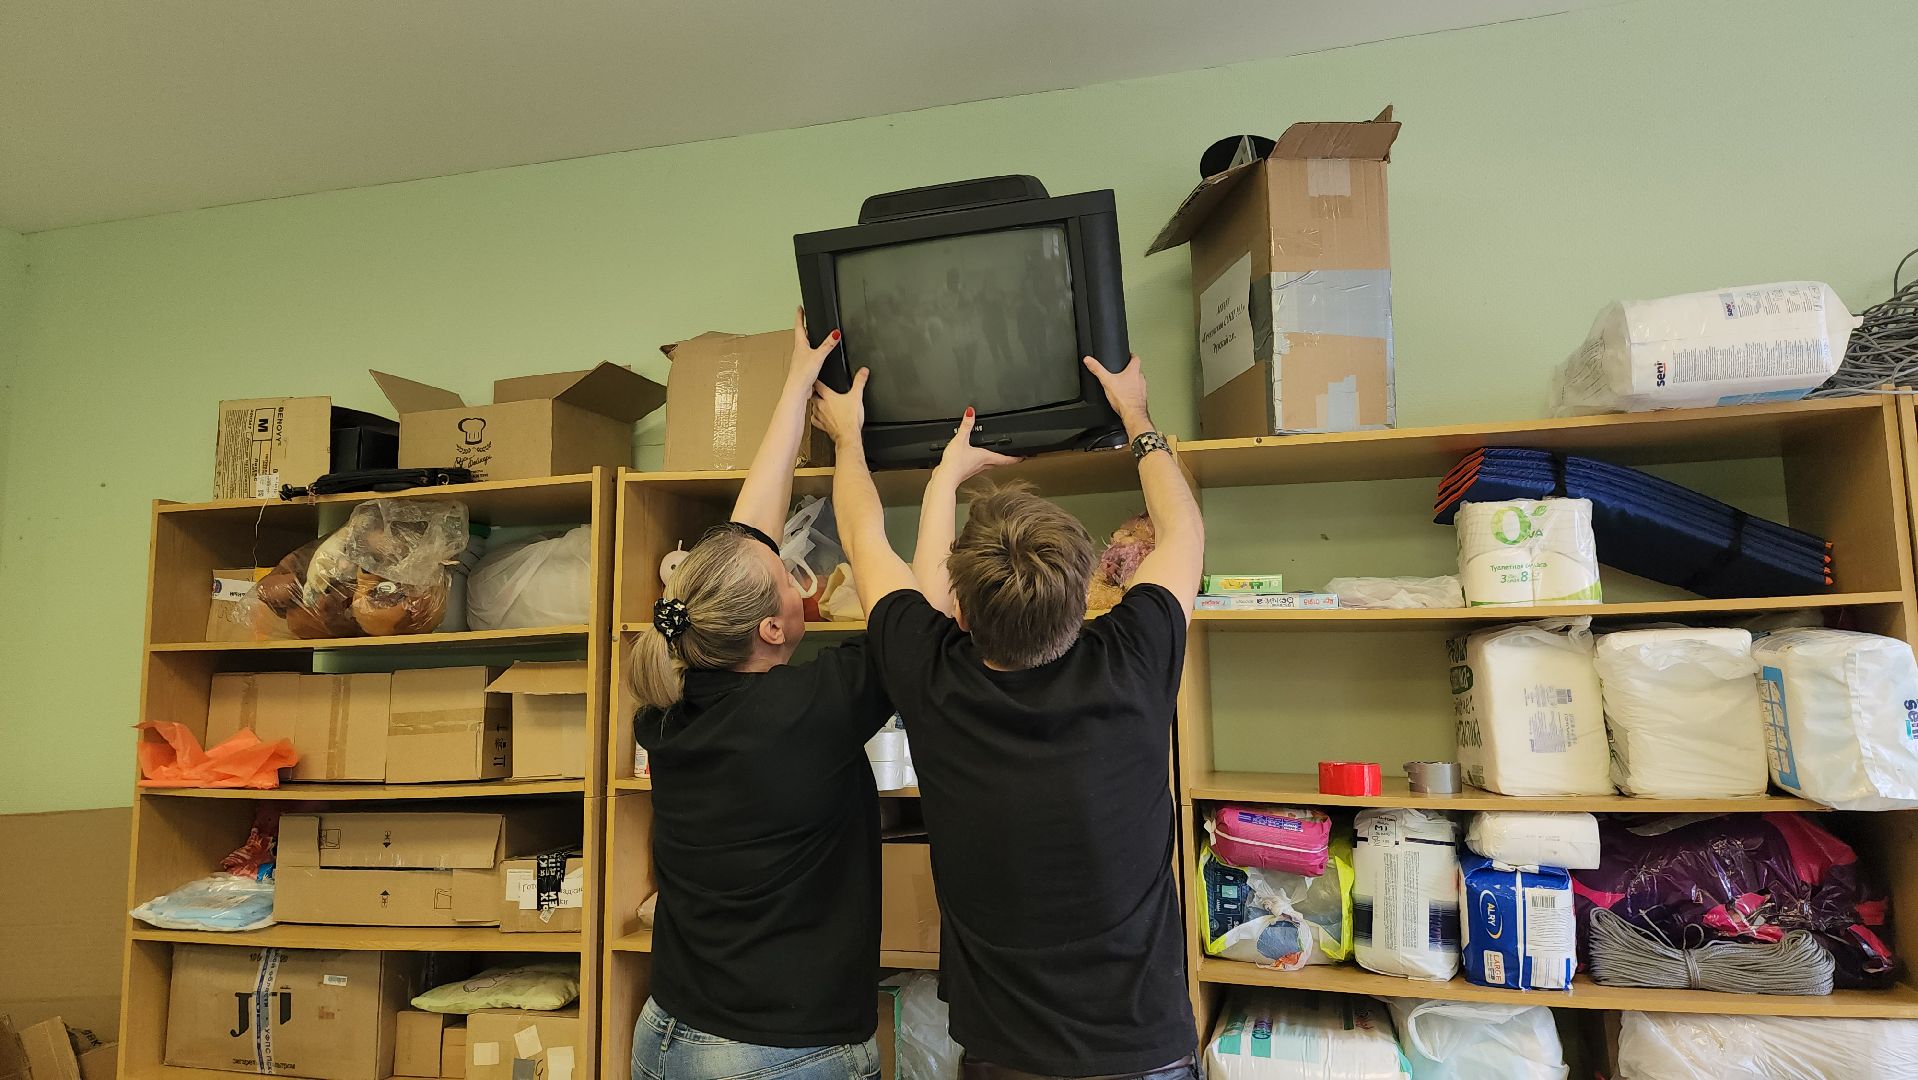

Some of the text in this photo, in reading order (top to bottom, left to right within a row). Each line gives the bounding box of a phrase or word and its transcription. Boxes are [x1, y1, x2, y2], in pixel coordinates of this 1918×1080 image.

[257, 418, 269, 433] M
[1520, 571, 1529, 582] 8
[1487, 902, 1496, 927] ALRY
